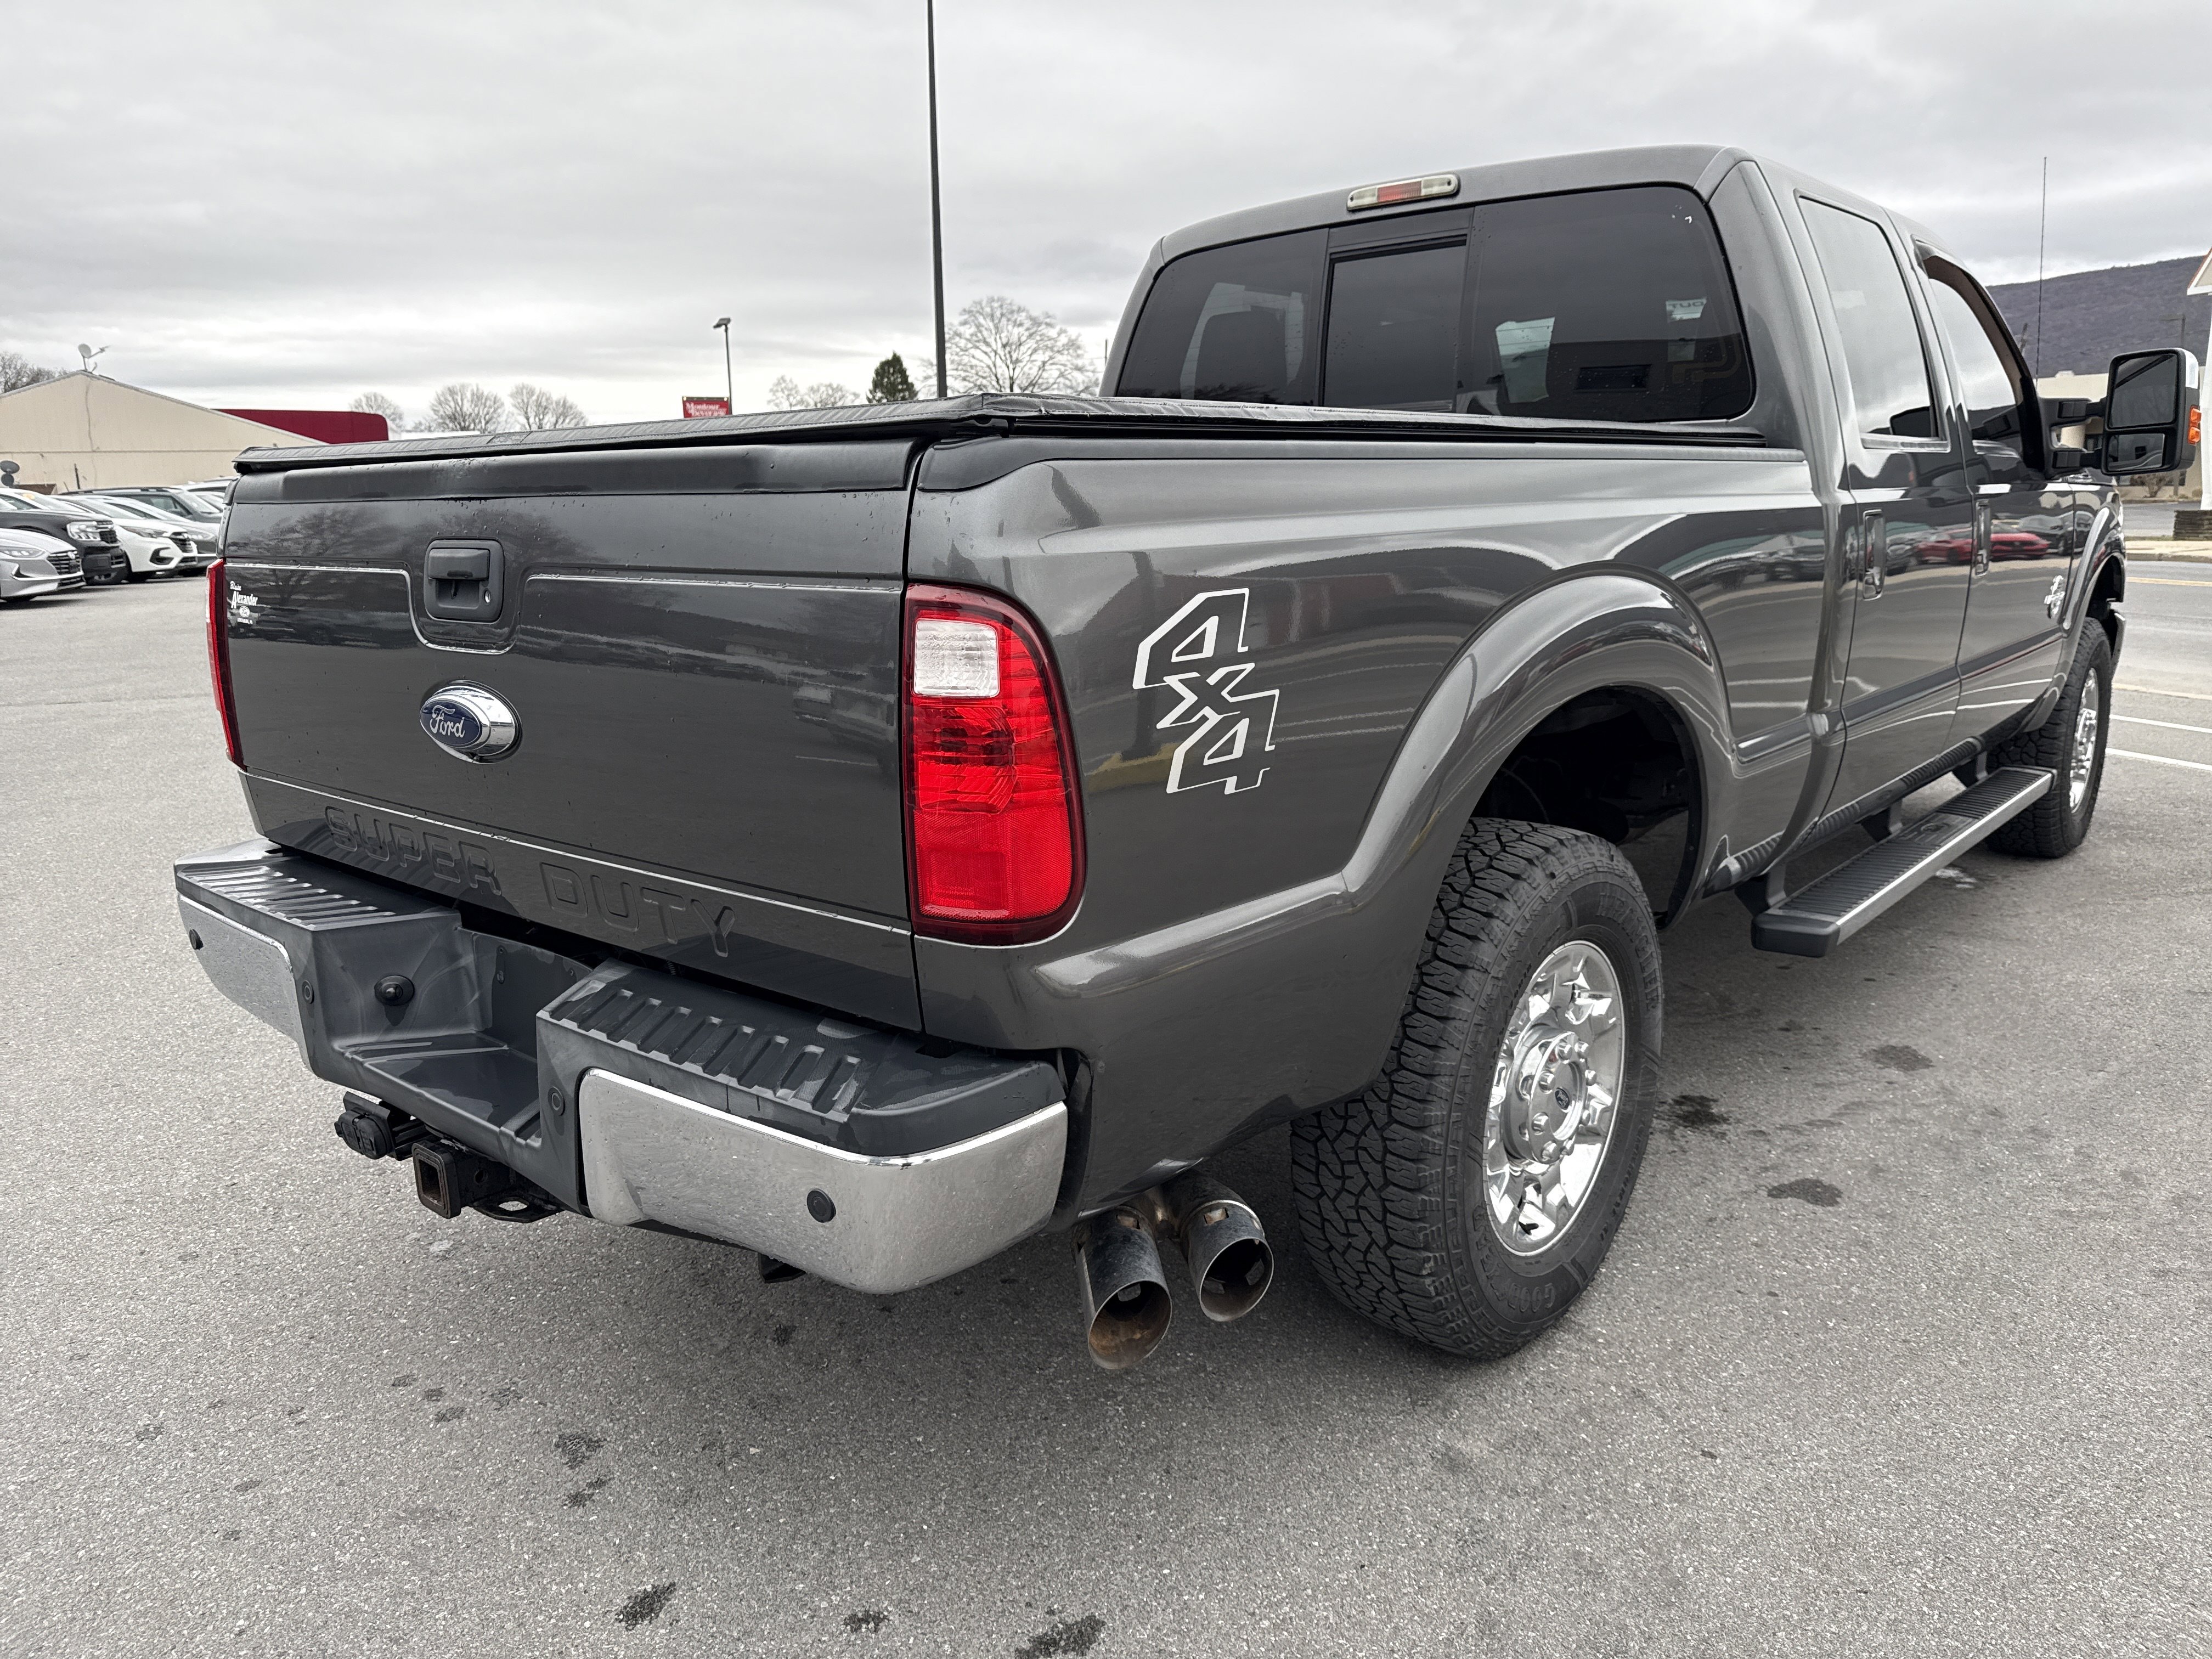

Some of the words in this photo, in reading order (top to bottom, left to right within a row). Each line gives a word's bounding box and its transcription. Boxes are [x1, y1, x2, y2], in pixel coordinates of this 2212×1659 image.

[231, 591, 258, 609] Alexander
[430, 705, 465, 738] Ford
[324, 805, 503, 896] SUPER
[539, 861, 737, 958] DUTY
